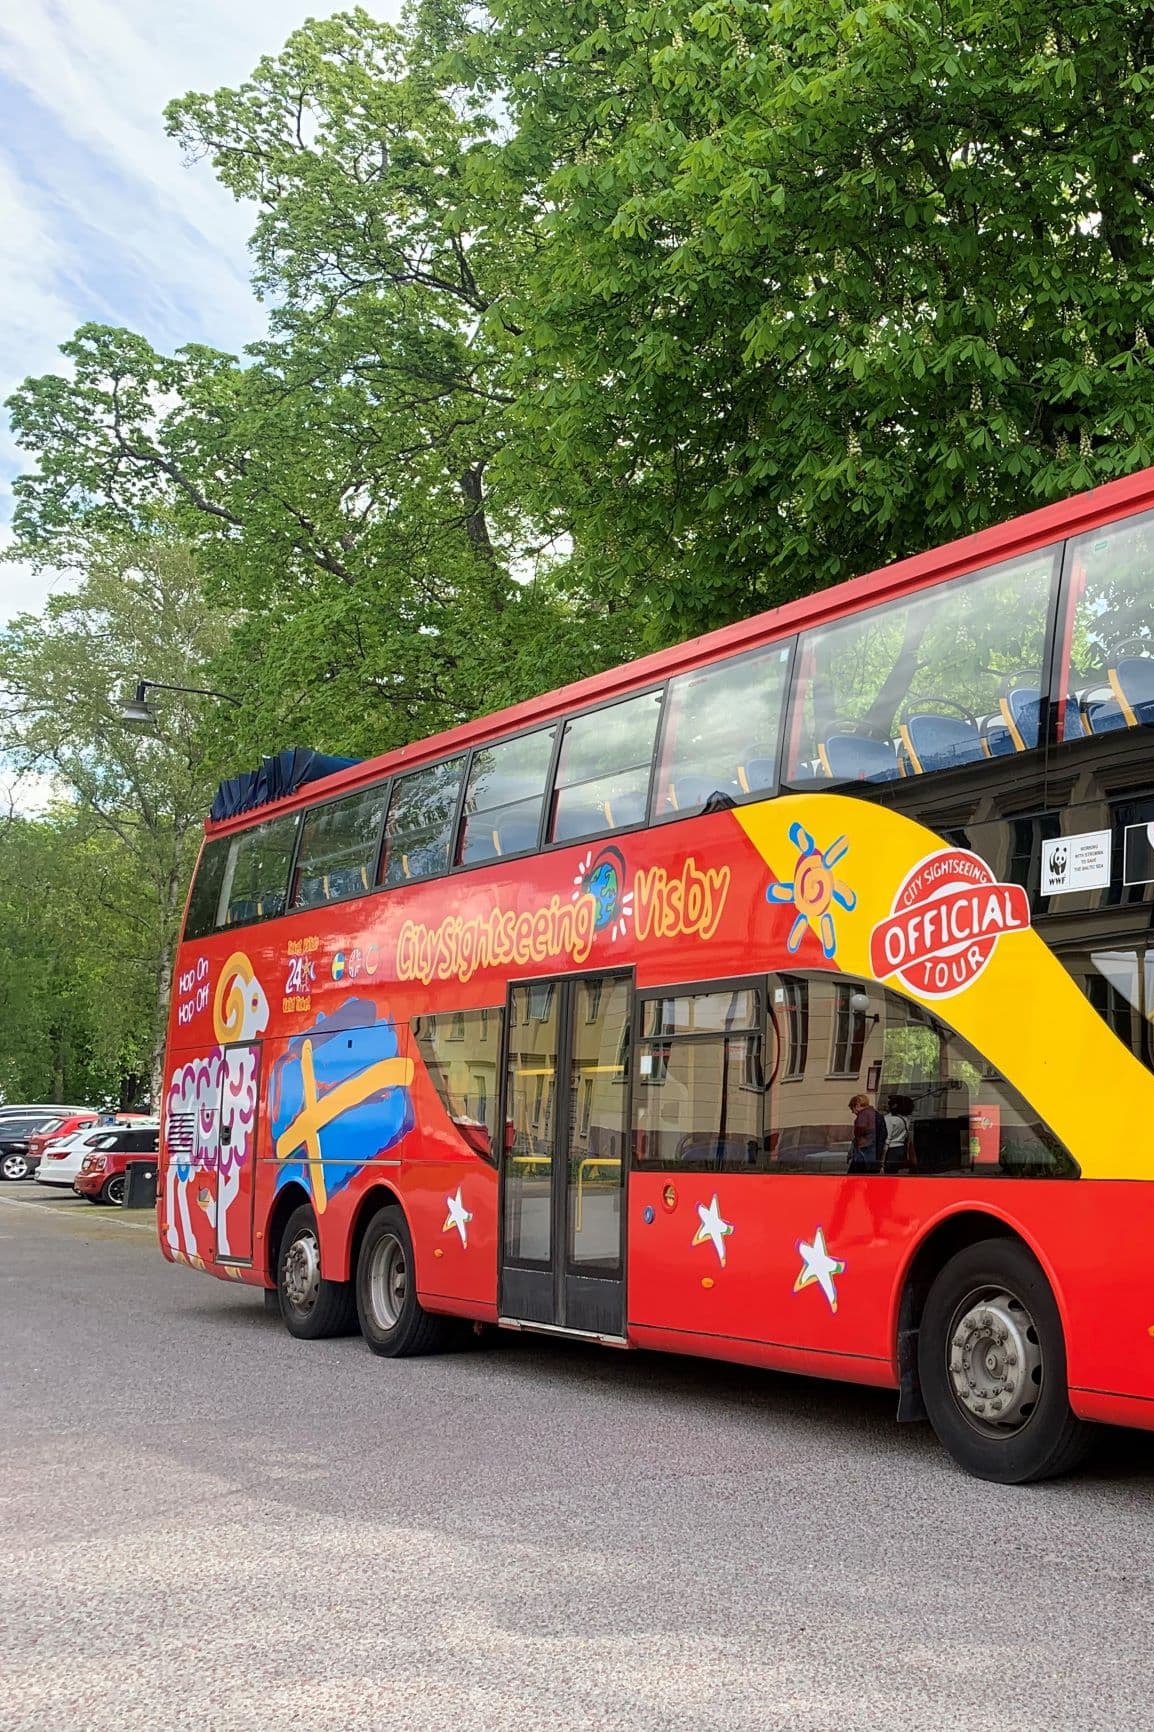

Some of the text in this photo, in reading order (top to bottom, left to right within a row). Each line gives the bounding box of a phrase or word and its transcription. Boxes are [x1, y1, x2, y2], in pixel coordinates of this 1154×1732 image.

[633, 857, 731, 941] Visby
[903, 859, 988, 906] CITY SIGHTSEEING
[1049, 877, 1067, 886] WWF
[884, 890, 1021, 966] OFFICIAL
[179, 957, 209, 995] Hop On
[923, 945, 985, 988] TOUR
[178, 983, 211, 1026] Hop Off
